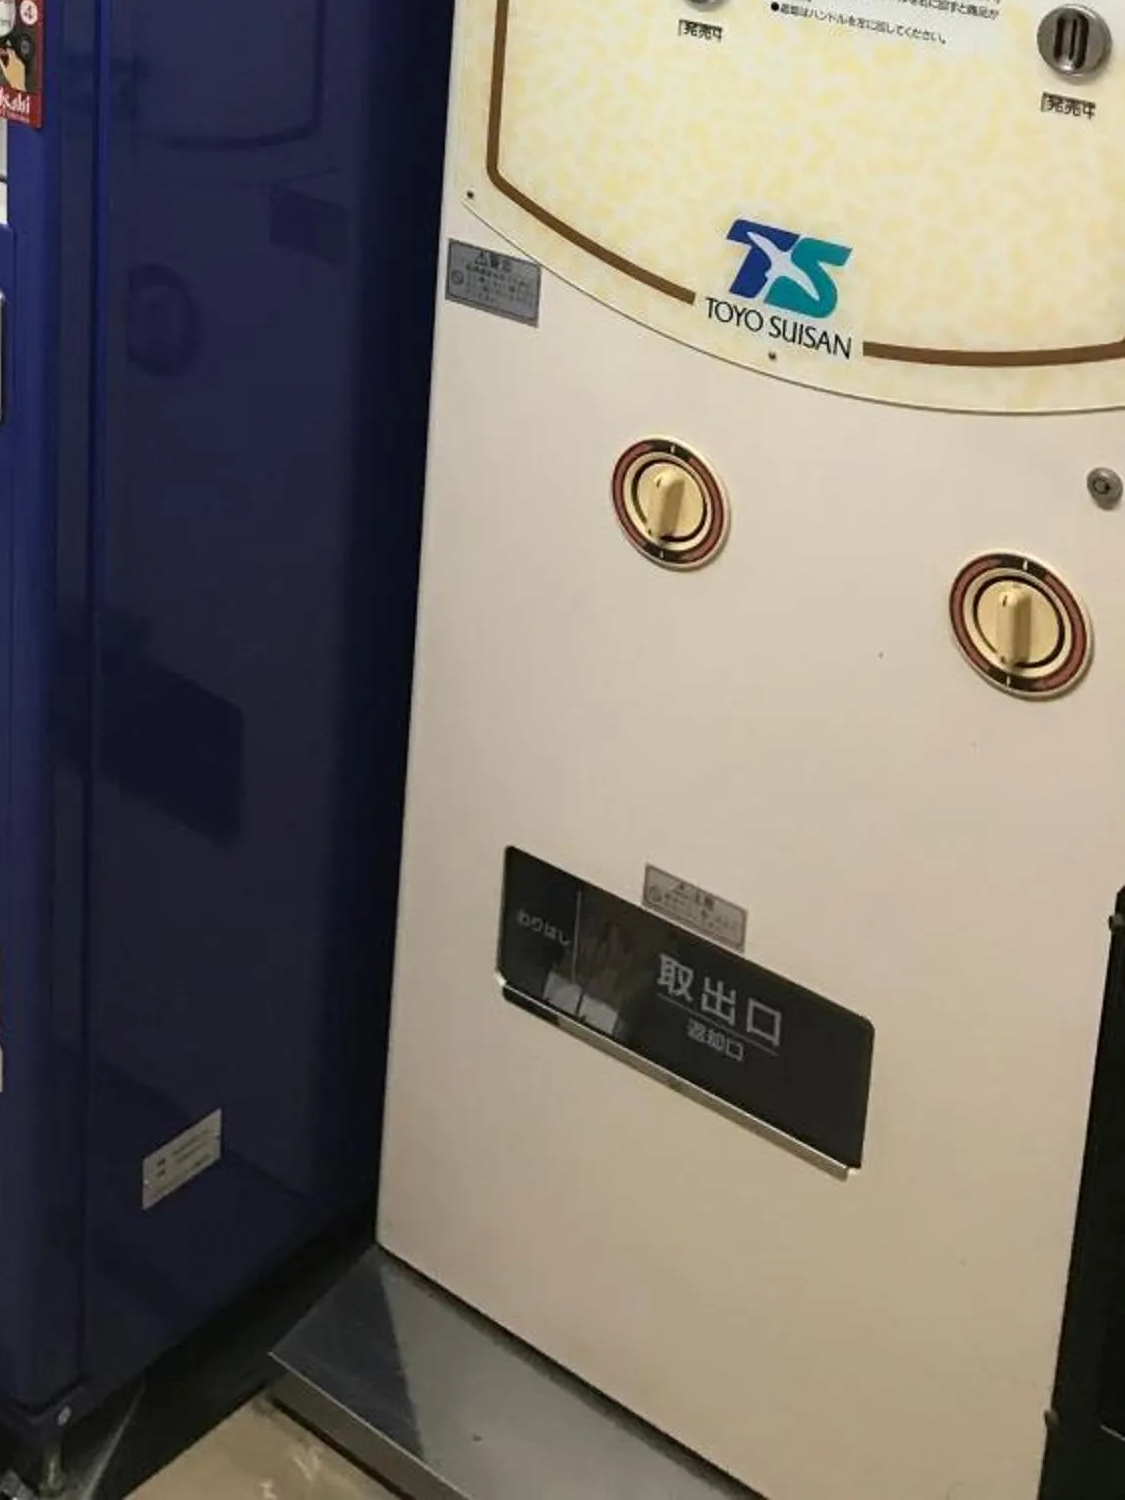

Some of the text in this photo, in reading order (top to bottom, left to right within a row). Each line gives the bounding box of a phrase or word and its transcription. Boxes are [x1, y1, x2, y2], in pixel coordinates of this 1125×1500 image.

[705, 296, 853, 361] TOYO SUISAN
[657, 952, 783, 1048] 取出口
